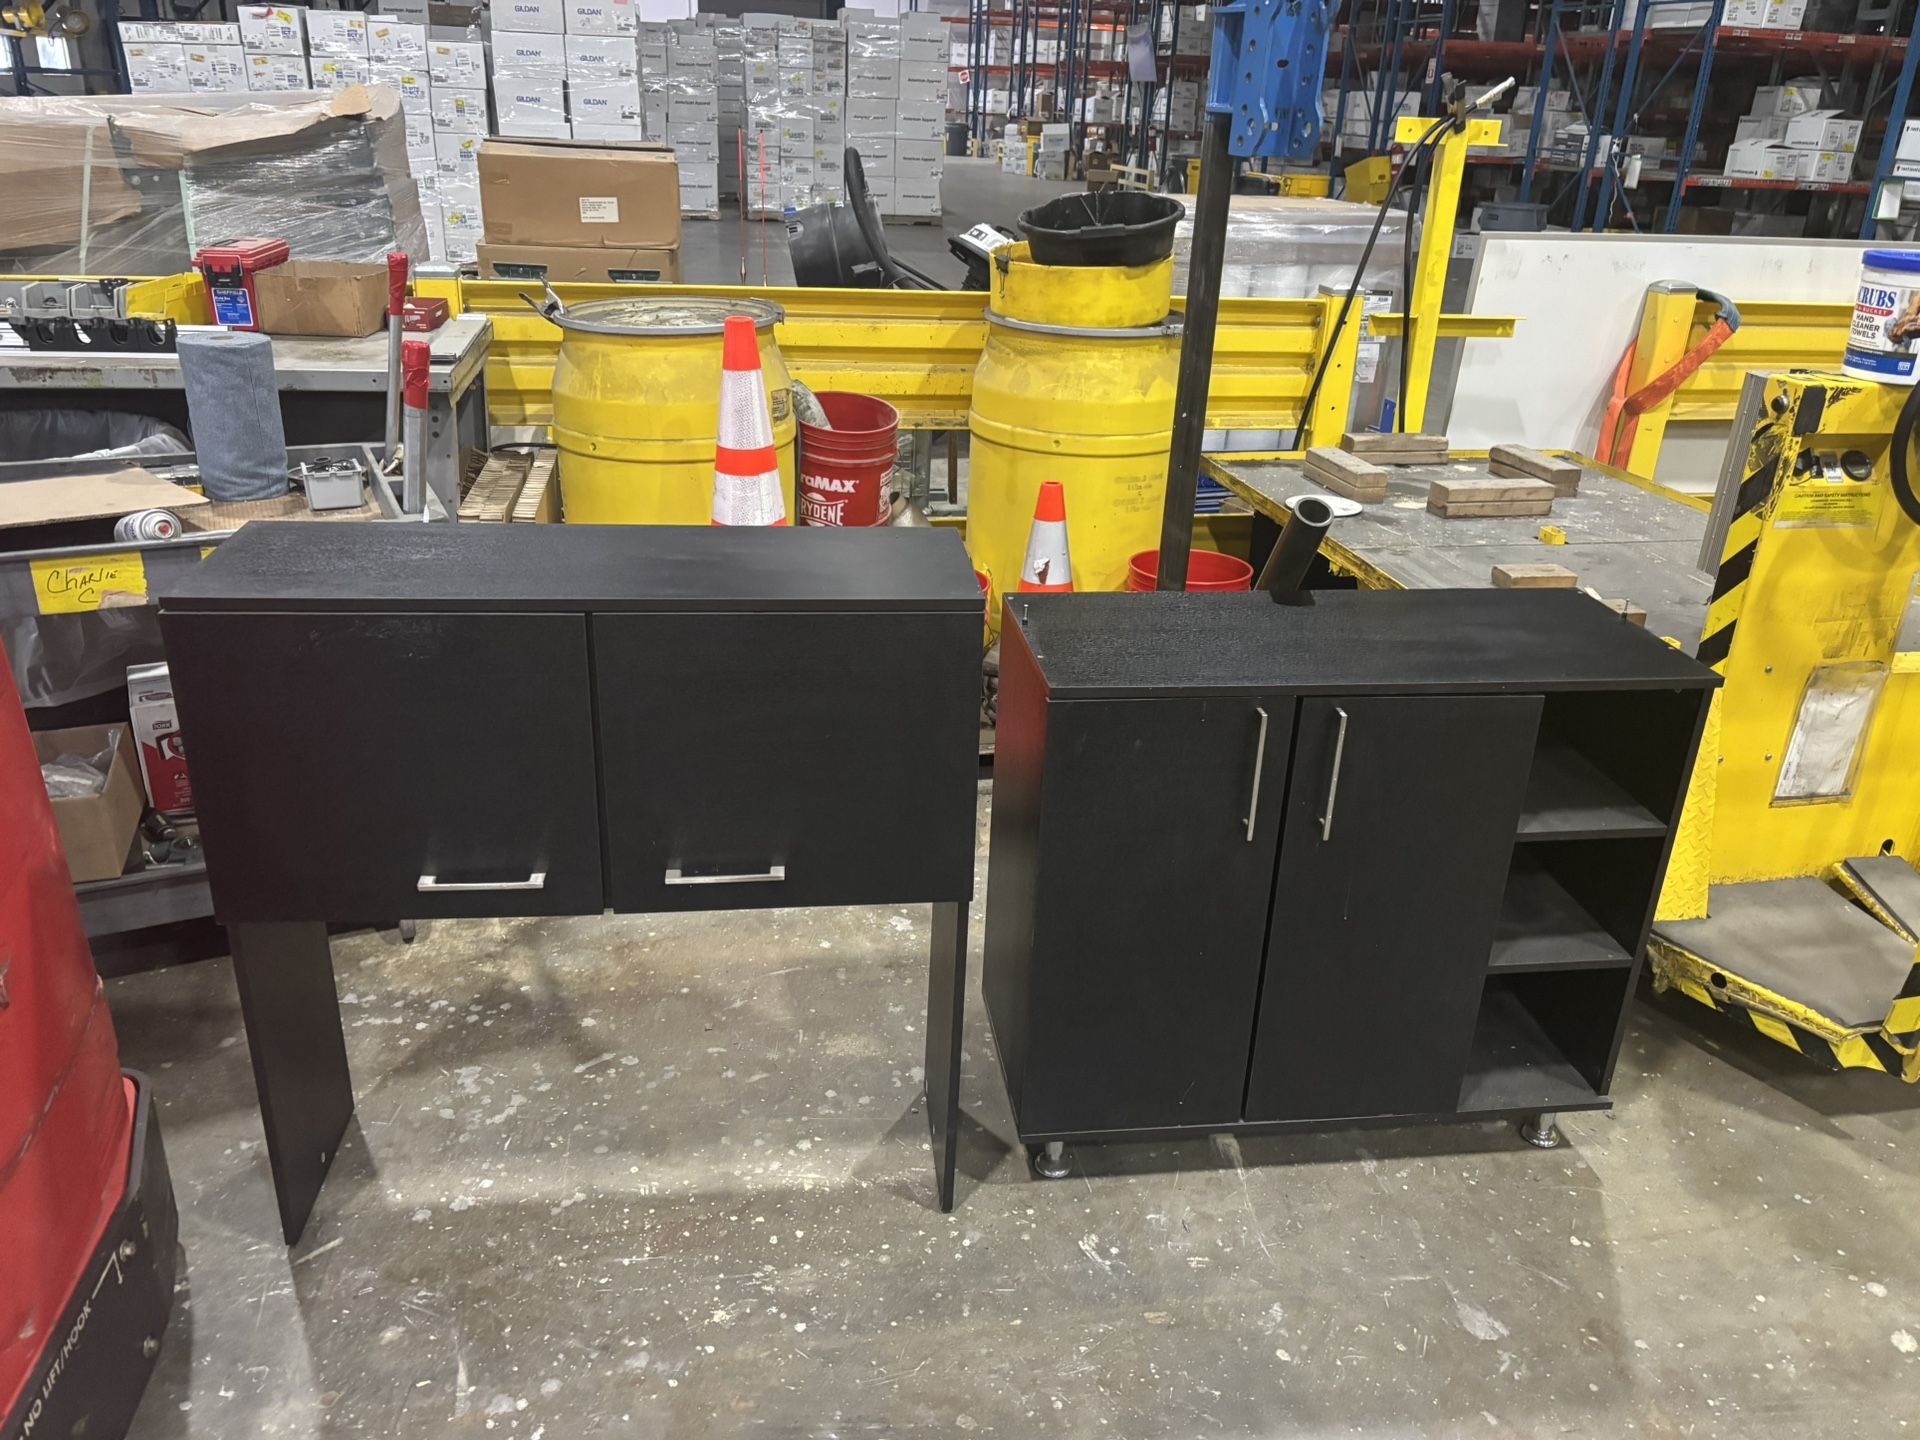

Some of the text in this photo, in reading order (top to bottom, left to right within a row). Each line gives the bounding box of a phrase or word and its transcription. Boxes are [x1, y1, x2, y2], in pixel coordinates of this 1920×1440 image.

[514, 5, 540, 13] GILDAN
[577, 8, 602, 16] GILDAN
[516, 49, 541, 57] GILDAN
[579, 55, 605, 63] GILDAN
[583, 98, 608, 106] GILDAN
[1856, 313, 1875, 323] HAND
[1852, 320, 1880, 332] CLEANER
[1850, 328, 1877, 339] TOWELS
[77, 587, 99, 604] C
[23, 1300, 92, 1437] NO LIFT/HOOK
